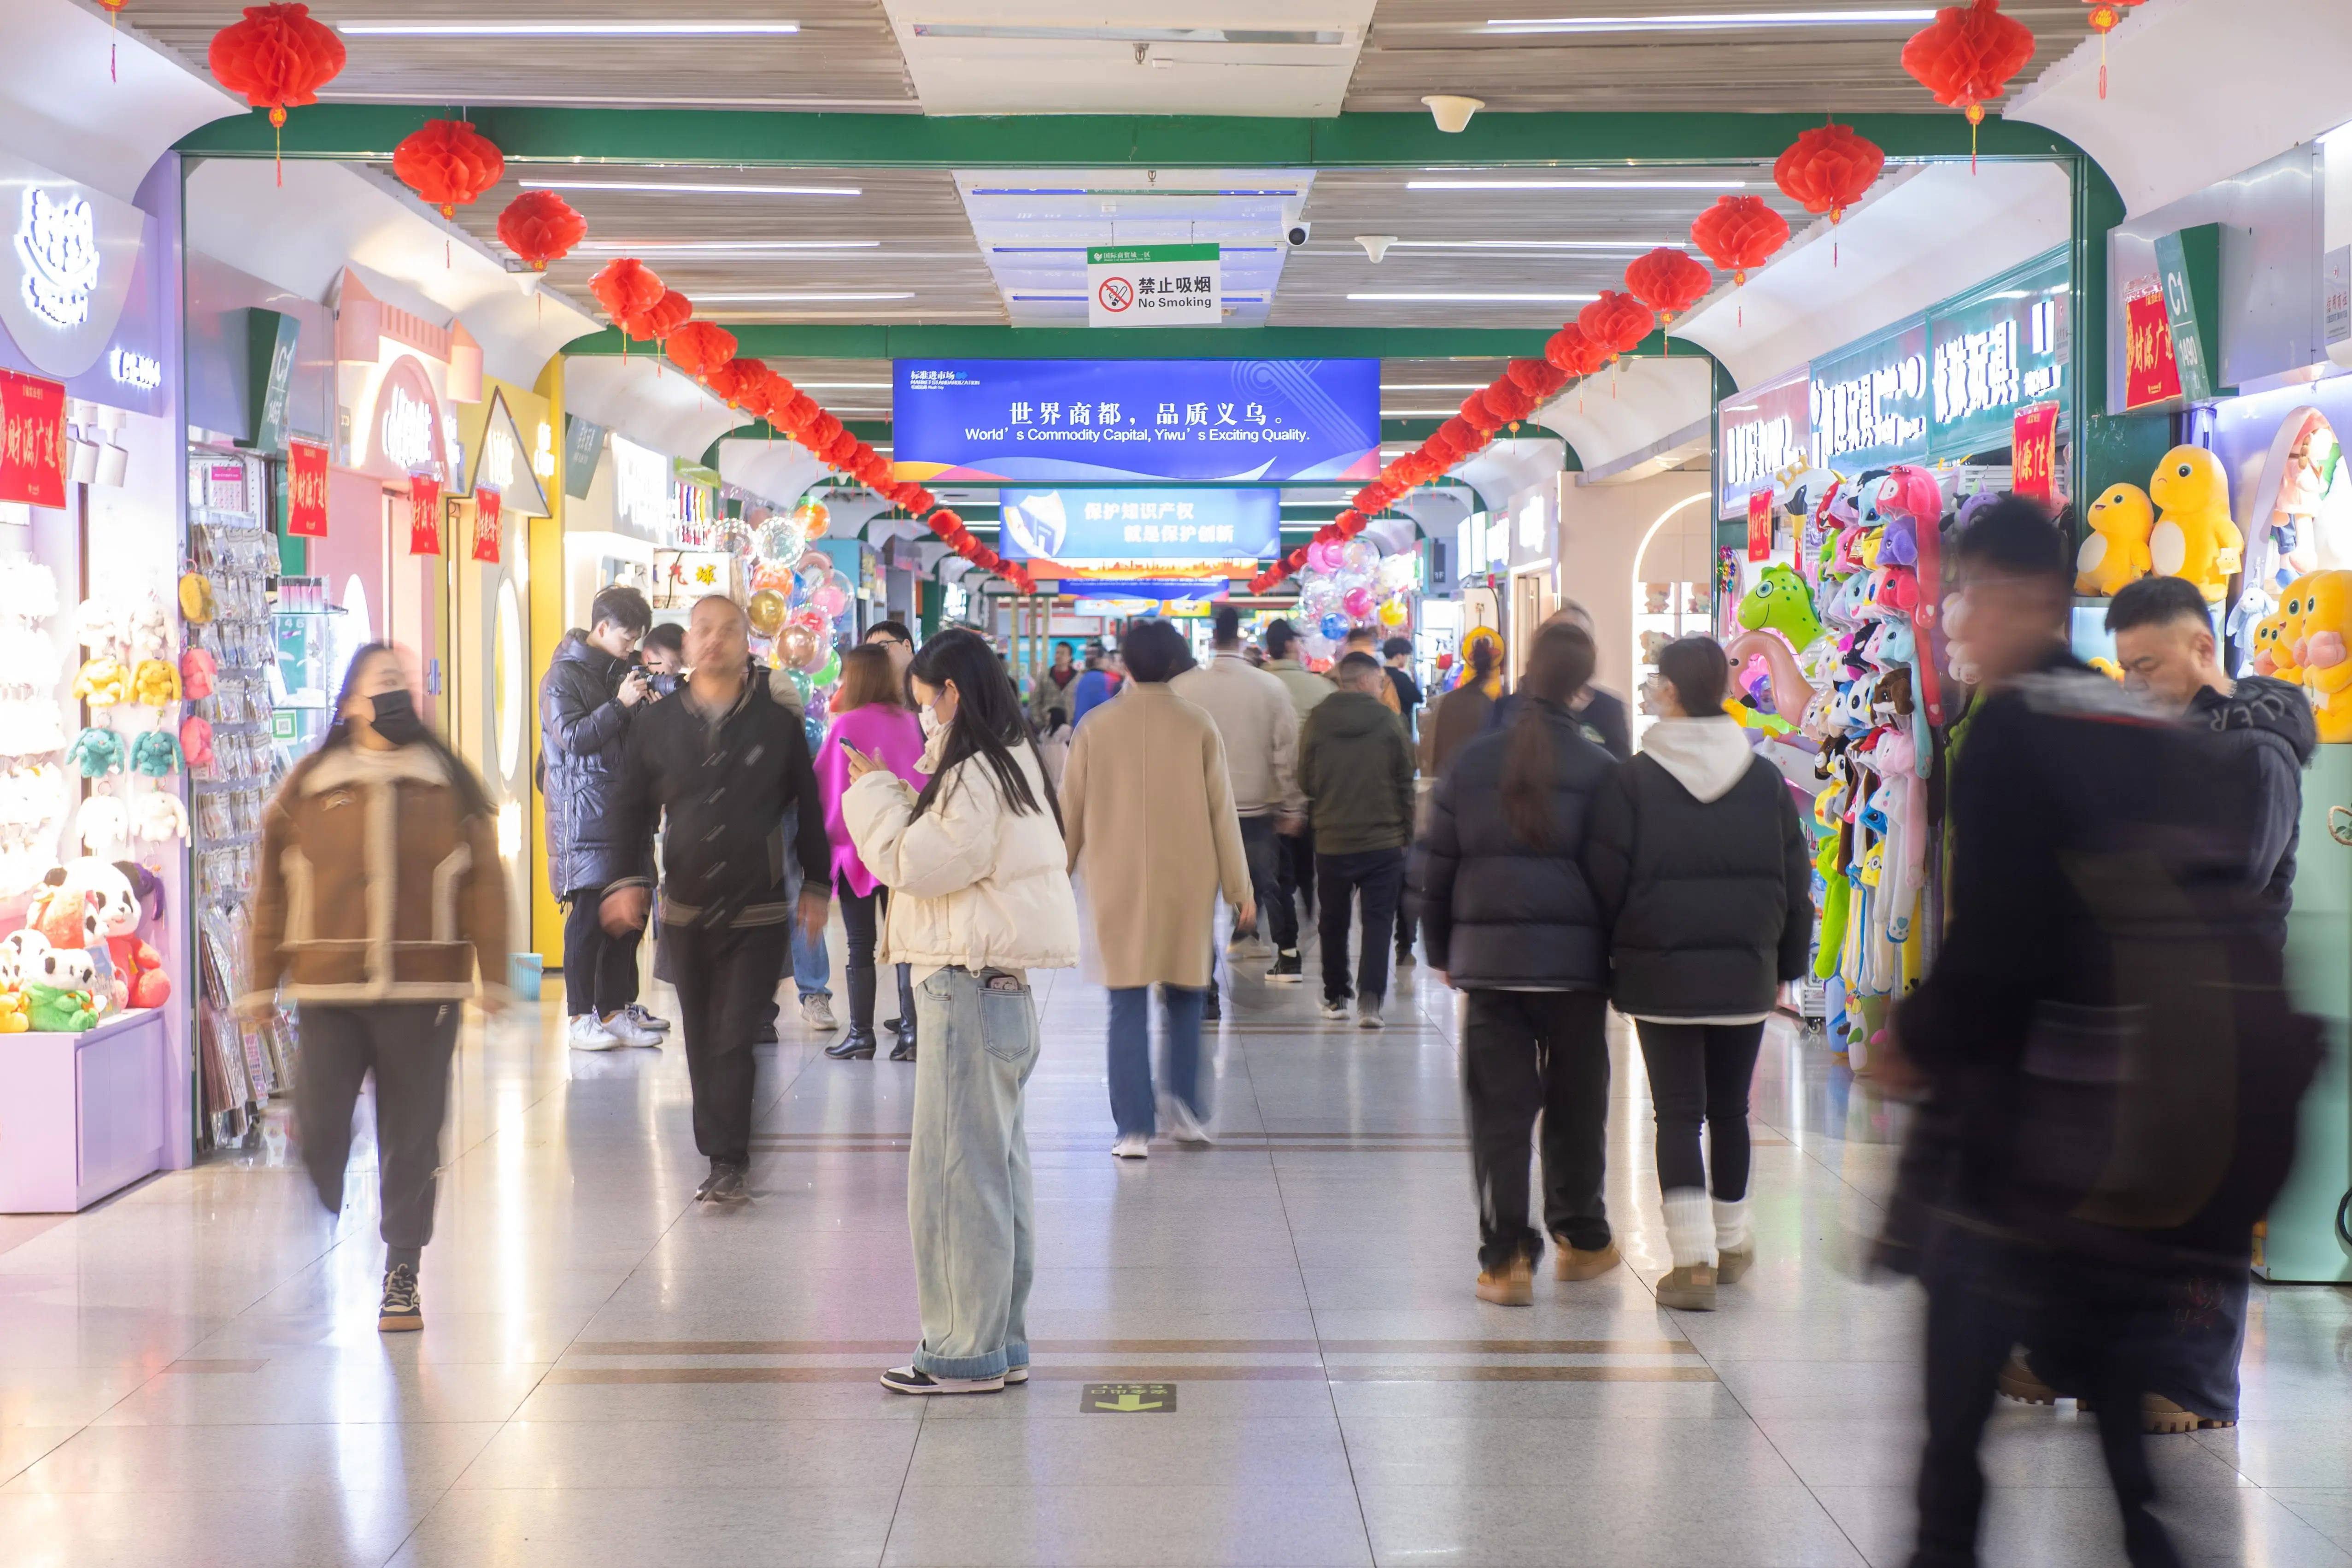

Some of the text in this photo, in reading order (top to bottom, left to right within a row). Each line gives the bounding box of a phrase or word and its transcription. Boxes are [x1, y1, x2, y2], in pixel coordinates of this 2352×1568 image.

[1138, 276, 1211, 295] 禁止吸烟
[2168, 271, 2188, 316] C1
[1138, 297, 1212, 308] No Smoking
[910, 370, 955, 380] 标准进市场
[1027, 428, 1101, 443] Commodity
[1103, 428, 1152, 443] Capital,
[1209, 428, 1260, 443] Exciting
[1262, 428, 1310, 443] Quality.
[1084, 502, 1195, 521] 保护知识产权
[1124, 524, 1235, 543] 就是保护创新
